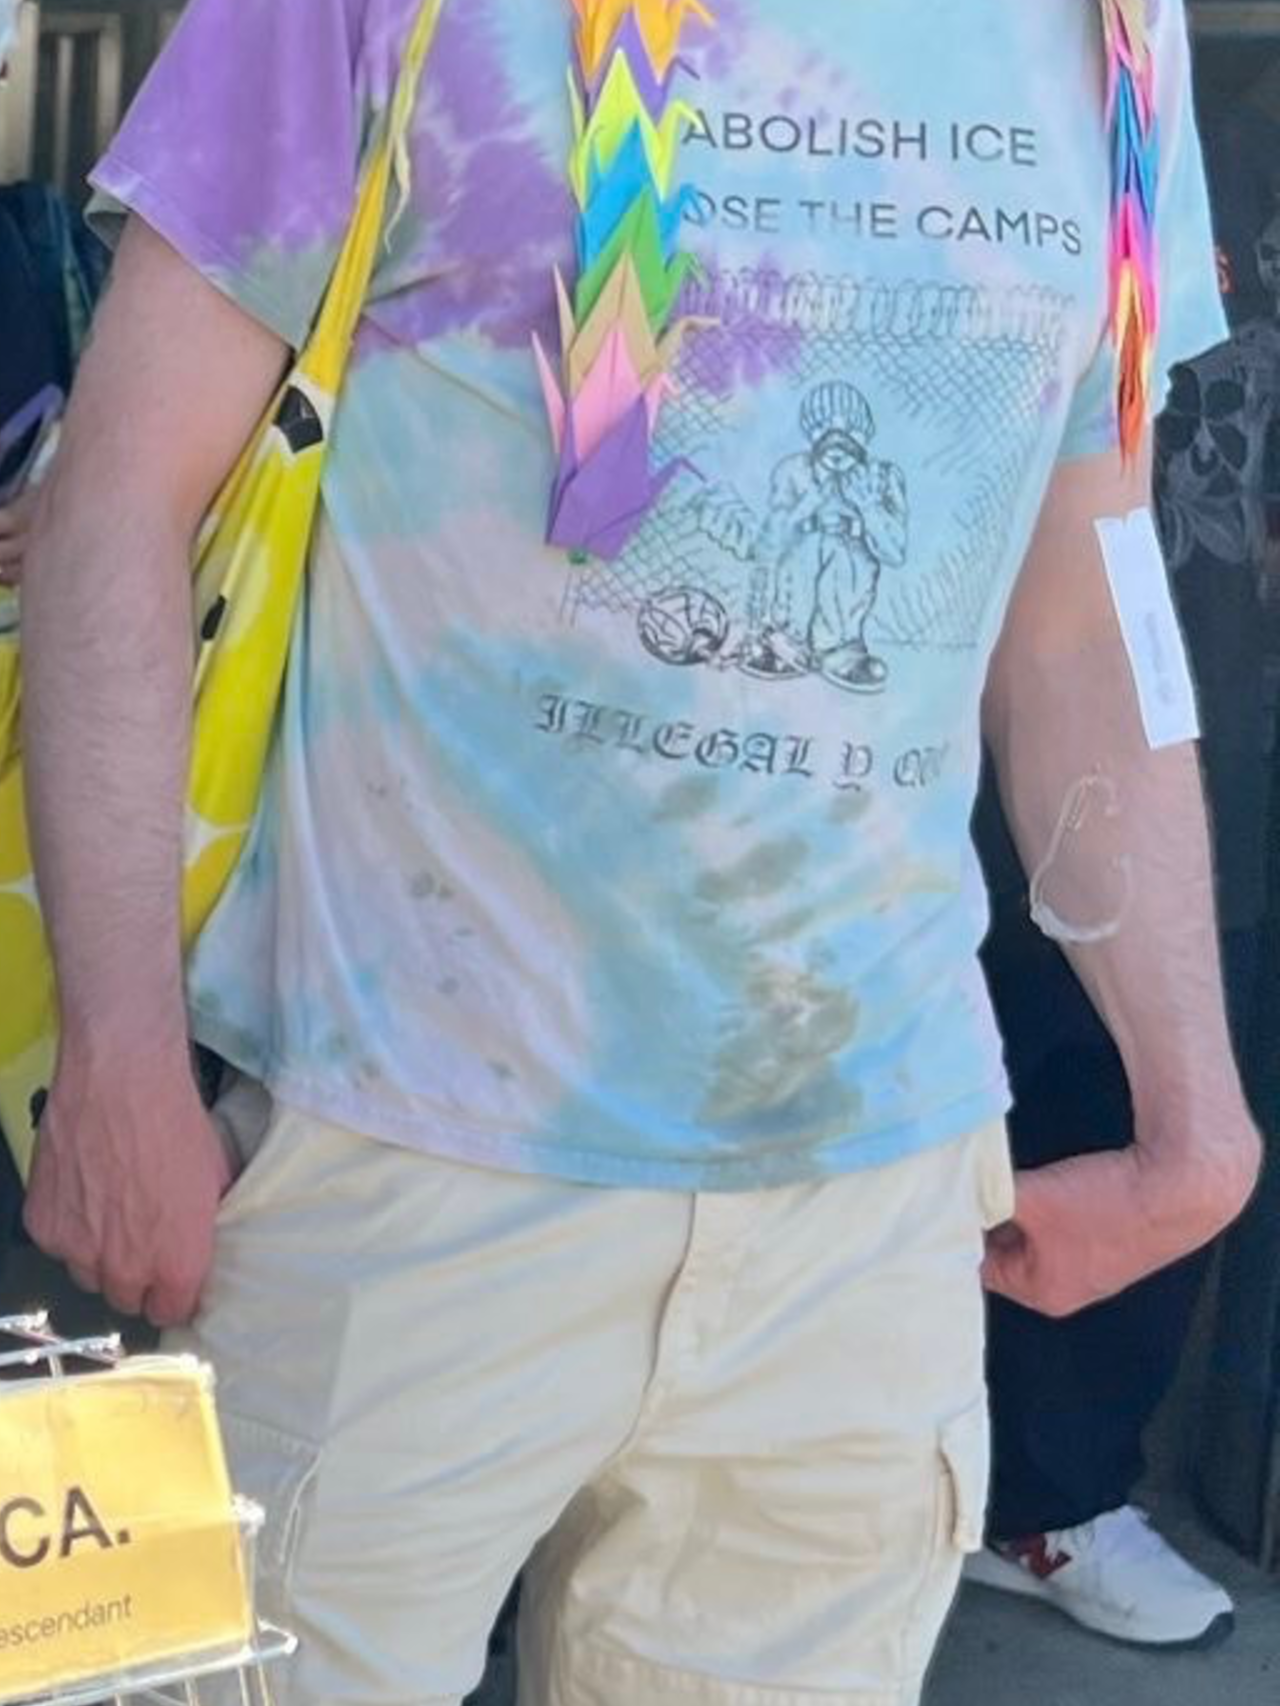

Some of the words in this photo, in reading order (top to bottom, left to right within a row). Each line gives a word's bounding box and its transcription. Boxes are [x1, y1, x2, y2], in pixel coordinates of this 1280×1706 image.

[681, 108, 927, 161] ABOLISH
[951, 122, 1038, 167] ICE
[798, 199, 898, 239] THE
[916, 204, 1082, 257] CAMPS
[534, 692, 815, 778] ILLEGAL
